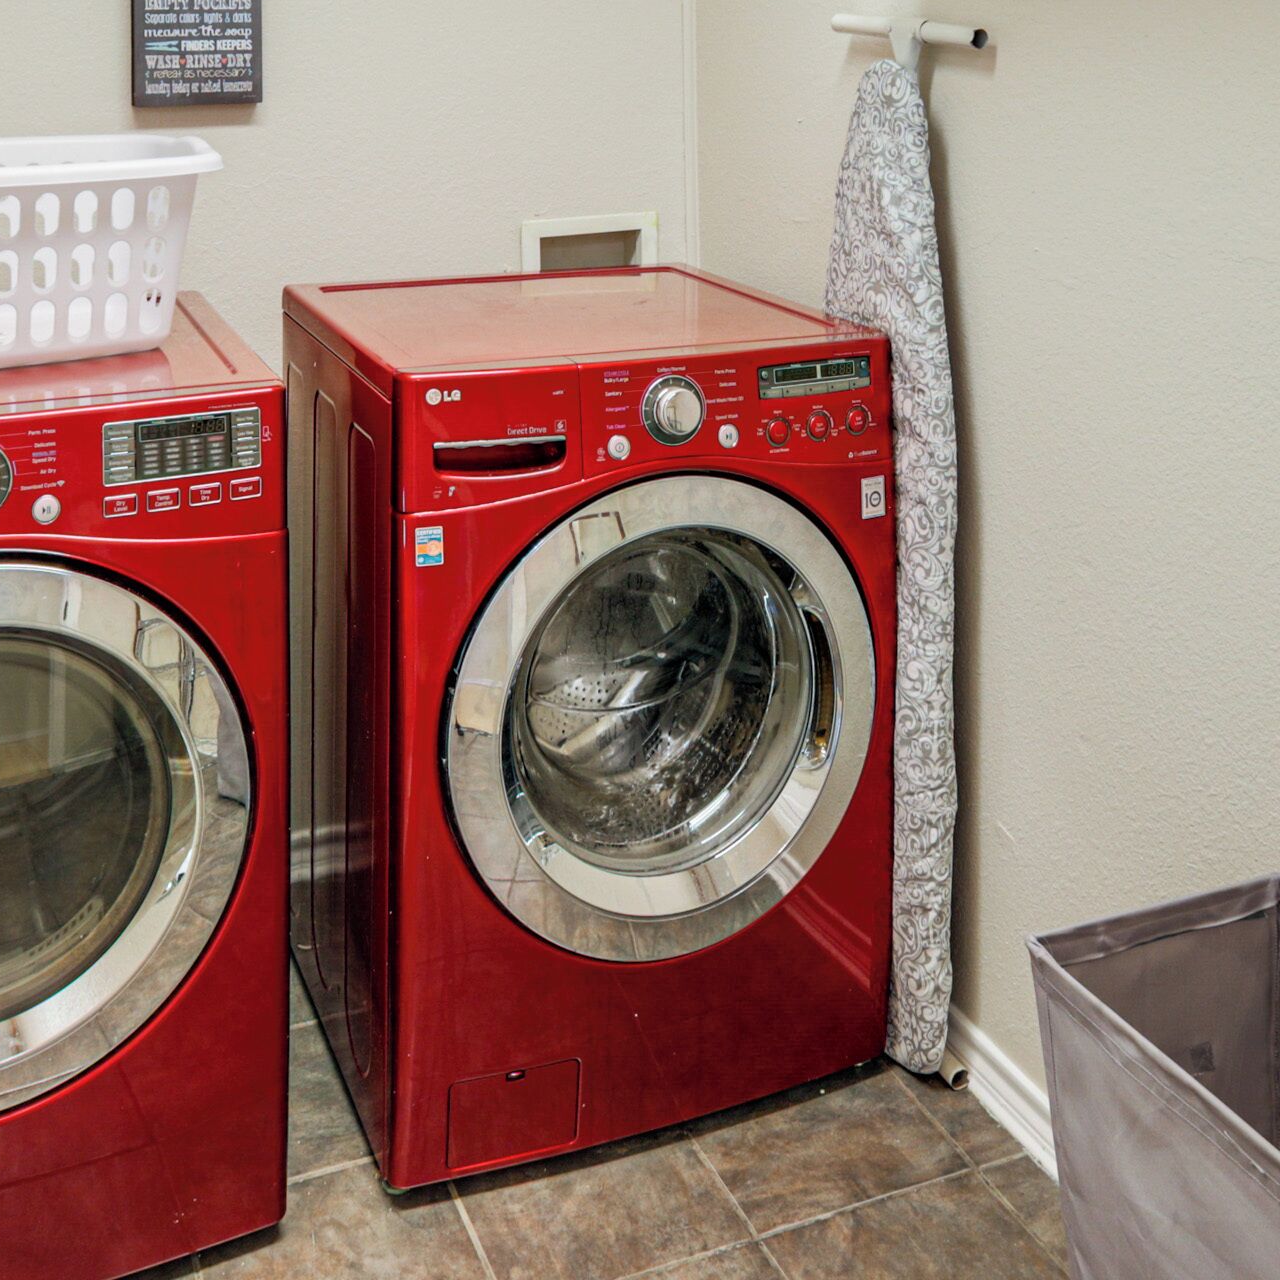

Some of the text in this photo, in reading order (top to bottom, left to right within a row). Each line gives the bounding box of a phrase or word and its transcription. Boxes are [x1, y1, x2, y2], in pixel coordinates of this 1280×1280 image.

[144, 24, 252, 39] measure the soap
[181, 39, 253, 52] FINDERS KEEPERS
[145, 53, 253, 69] WASH RINSE DRY
[153, 68, 247, 79] repeat as necessary
[443, 389, 461, 402] LG
[507, 426, 547, 435] Direct Drive
